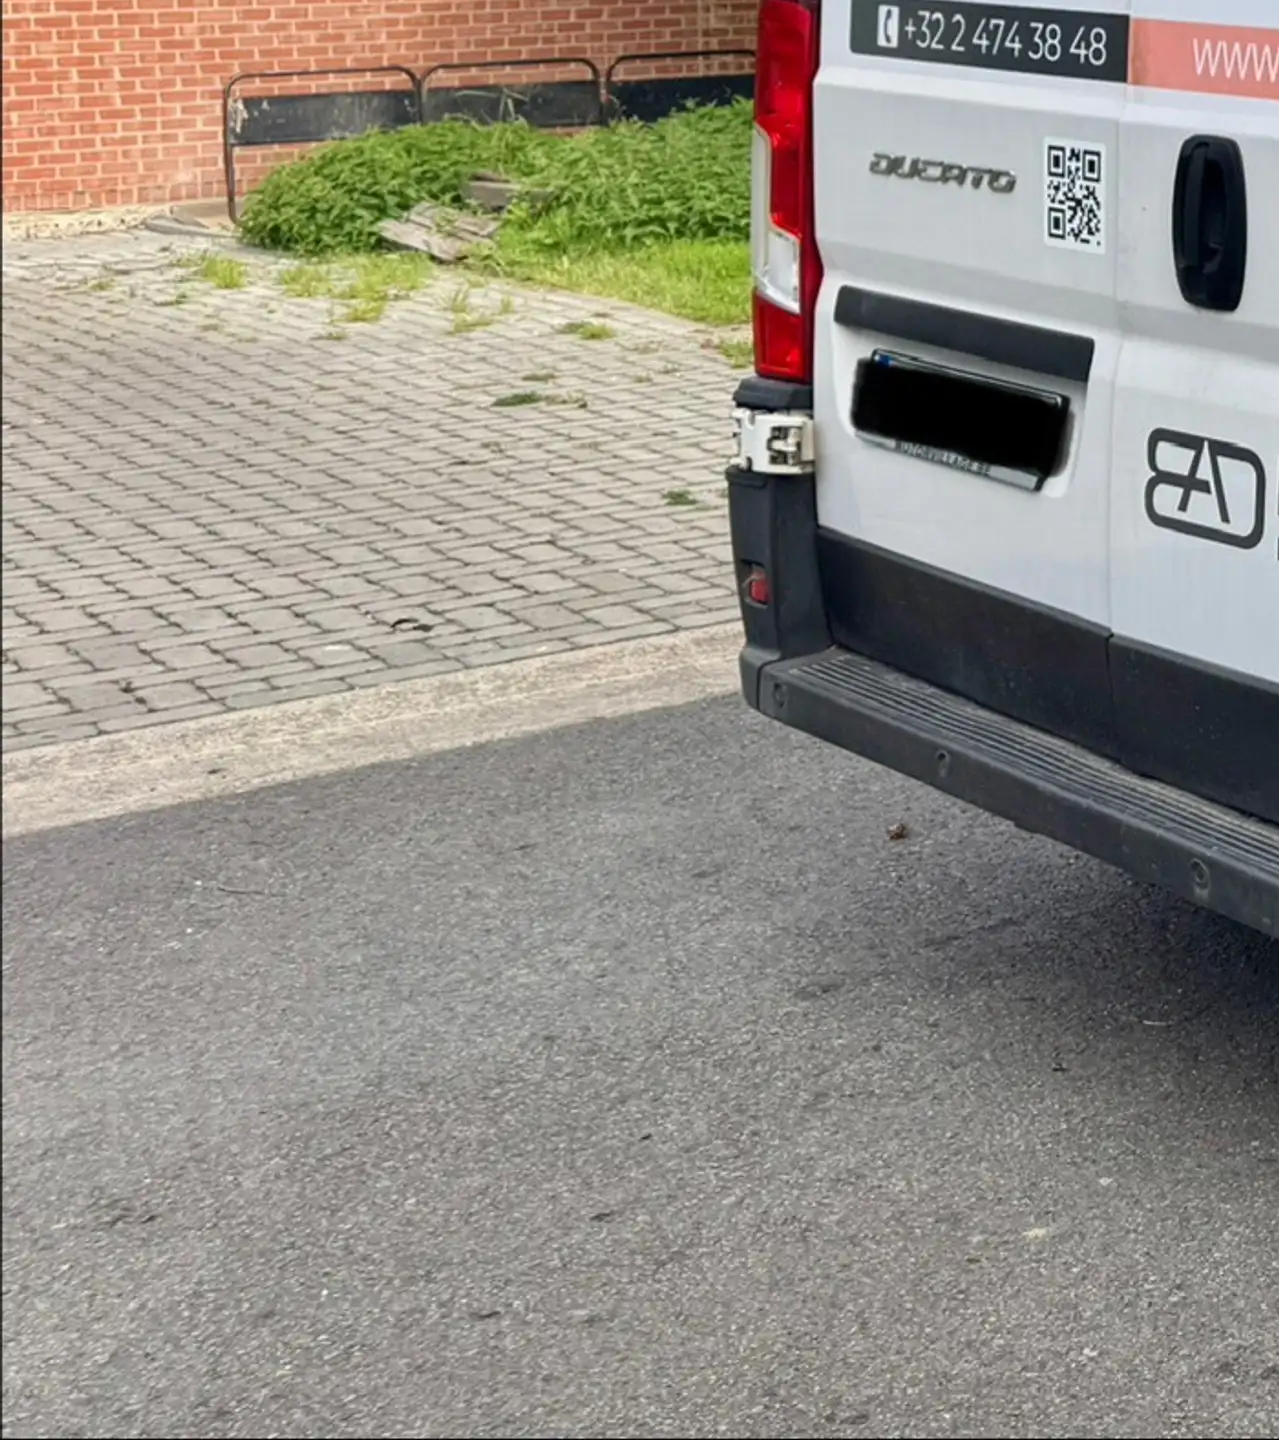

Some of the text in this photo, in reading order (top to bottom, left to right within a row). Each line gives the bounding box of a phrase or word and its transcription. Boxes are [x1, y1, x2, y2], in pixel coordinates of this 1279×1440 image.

[904, 10, 1108, 66] +32 2 474 38 48
[869, 152, 1017, 194] DUCATO
